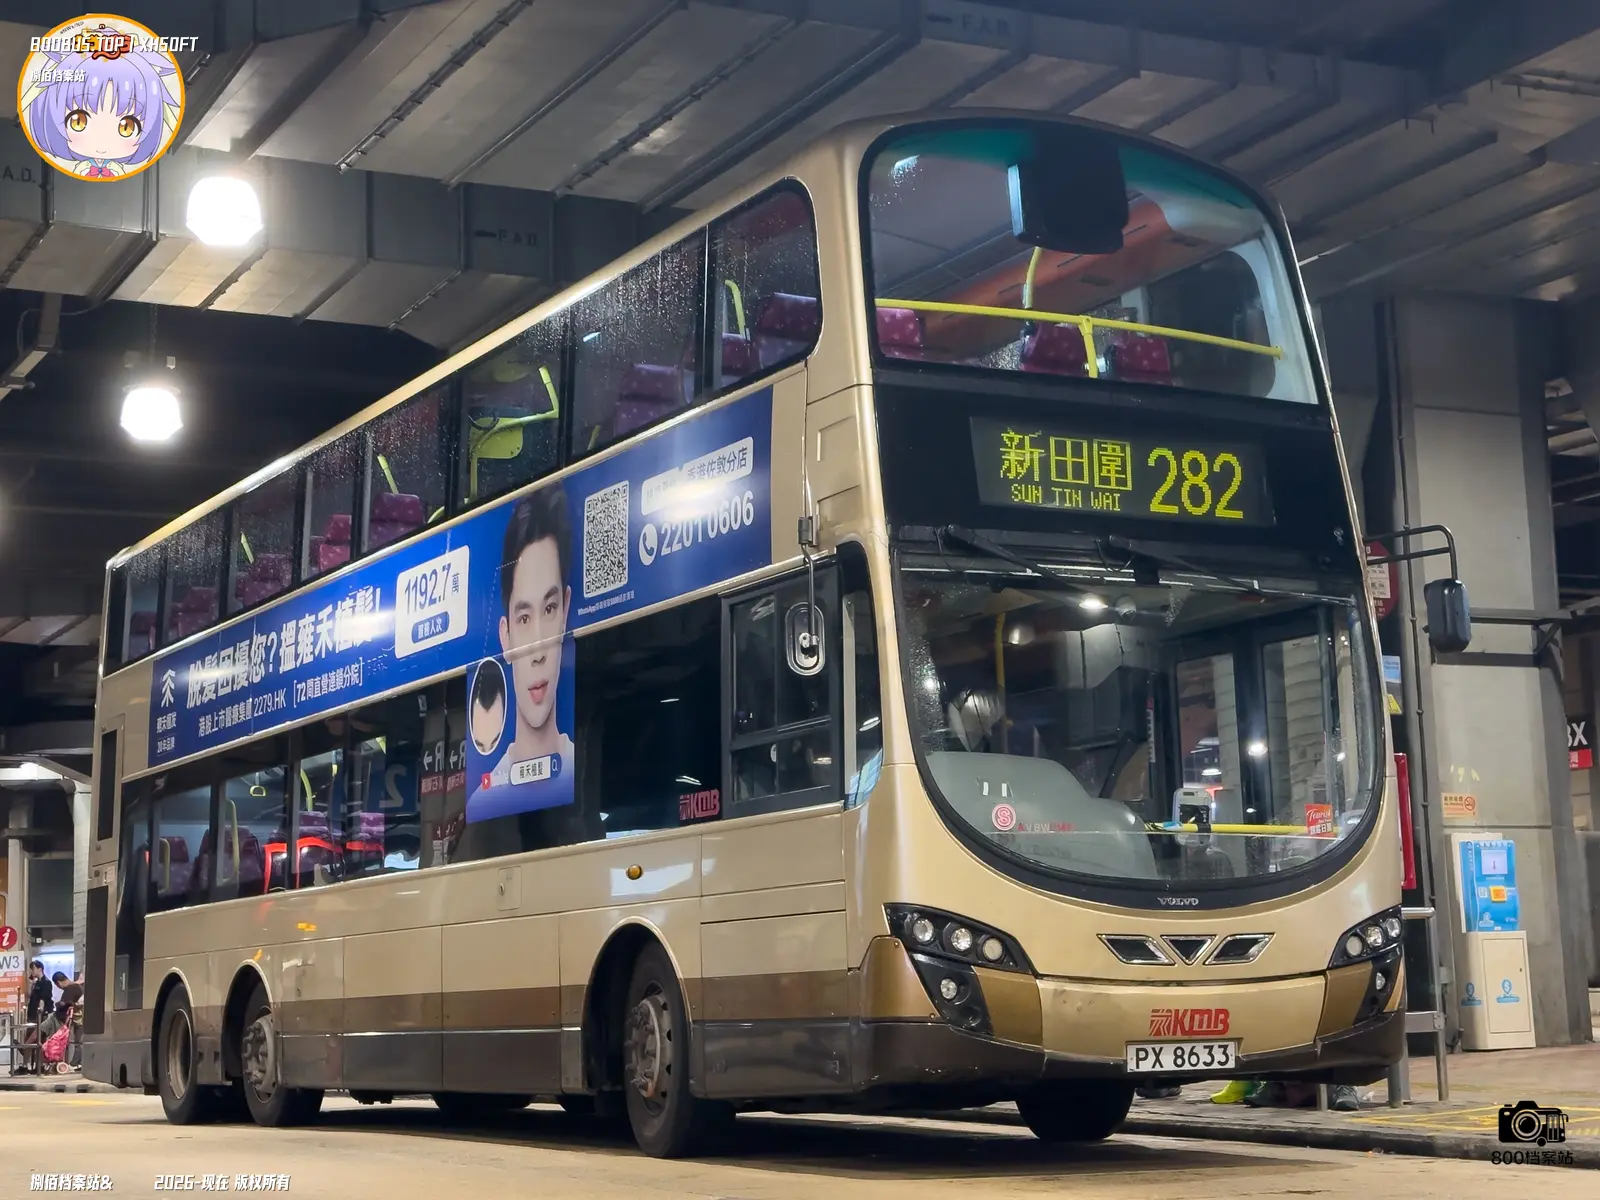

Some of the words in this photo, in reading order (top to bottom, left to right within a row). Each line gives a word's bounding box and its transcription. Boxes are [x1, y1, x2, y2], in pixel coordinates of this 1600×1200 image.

[1000, 427, 1132, 490] 新田圍
[1011, 483, 1042, 504] SUN
[1051, 487, 1082, 508] TIN
[1091, 490, 1121, 512] WAI
[1148, 447, 1244, 519] 282
[404, 562, 451, 614] 1192.7
[253, 688, 287, 717] 2279.HK
[690, 789, 720, 819] KMB
[1157, 896, 1200, 906] VOLVO
[1171, 1008, 1230, 1036] KMB
[1135, 1046, 1164, 1069] PX
[1172, 1044, 1230, 1068] 8633
